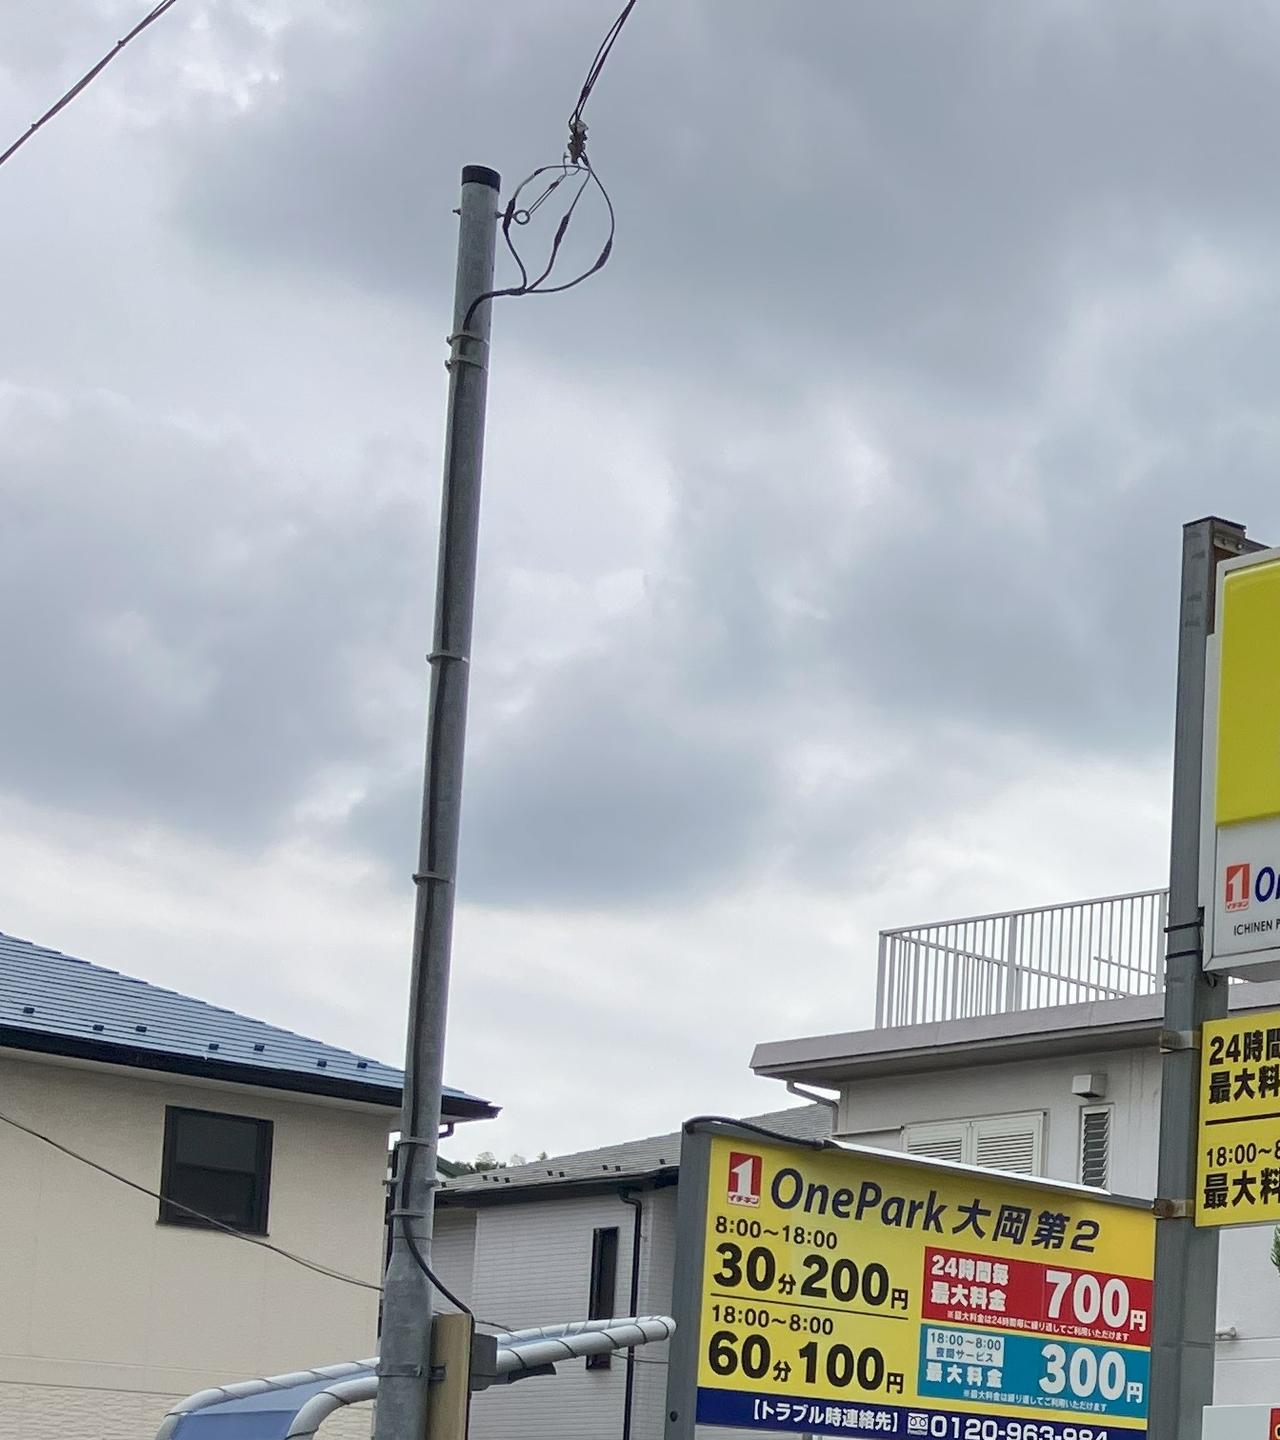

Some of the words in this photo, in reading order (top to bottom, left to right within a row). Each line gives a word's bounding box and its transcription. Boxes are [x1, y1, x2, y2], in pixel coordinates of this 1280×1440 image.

[1233, 920, 1273, 936] ICHINEN
[931, 1254, 1009, 1287] 24時間毎
[931, 1281, 1006, 1312] 最大料金
[926, 1361, 1003, 1389] 最大料金
